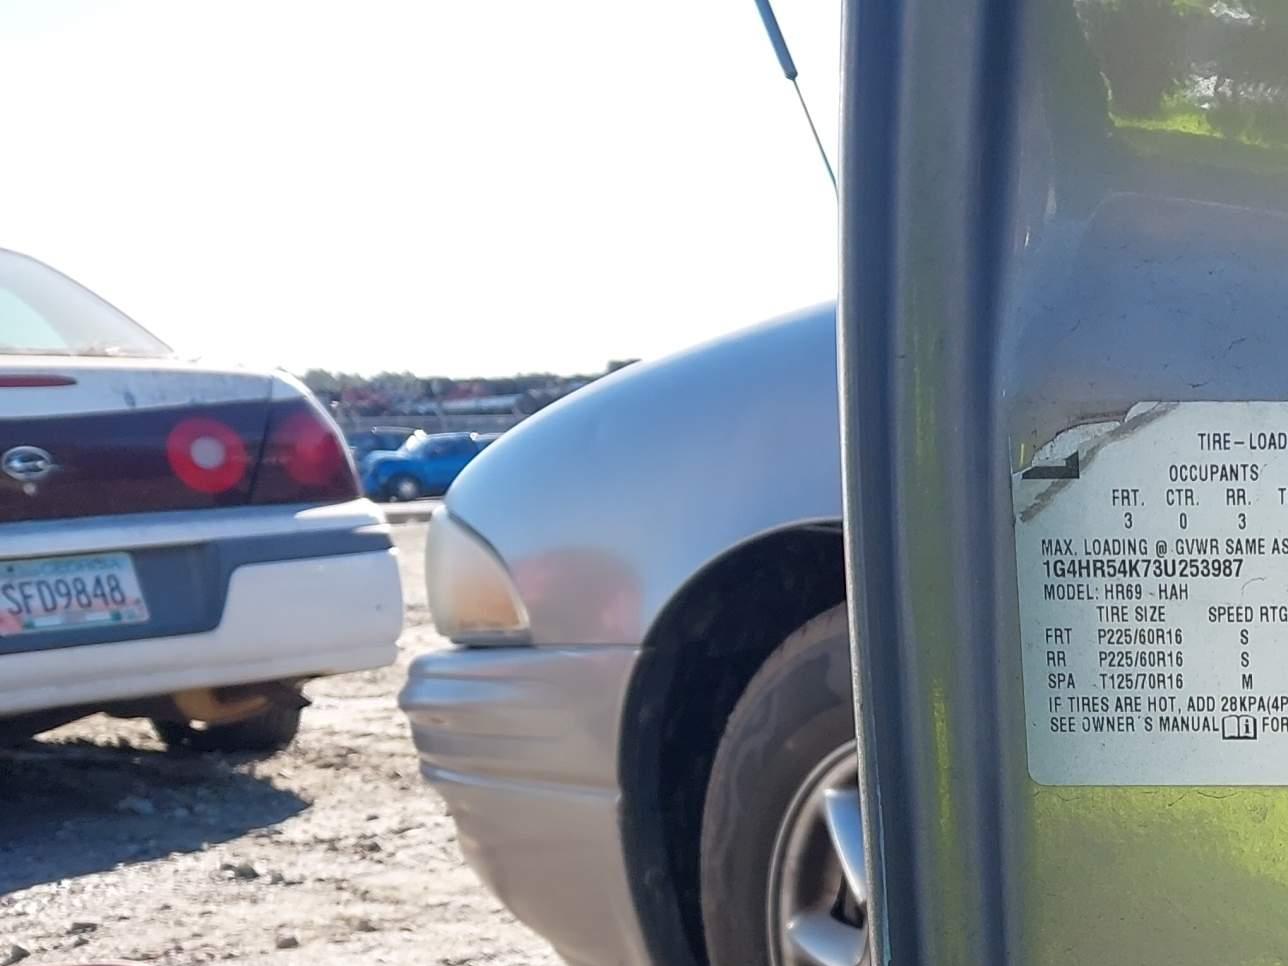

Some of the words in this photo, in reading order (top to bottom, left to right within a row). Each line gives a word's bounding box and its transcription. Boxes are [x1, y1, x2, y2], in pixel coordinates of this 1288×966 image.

[1169, 464, 1258, 482] OCCUPANTS
[1112, 489, 1144, 506] FRT.
[1167, 489, 1199, 506] CTR.
[1227, 488, 1251, 505] RR.
[1124, 512, 1132, 529] 3
[1180, 513, 1187, 529] 0
[1238, 513, 1246, 530] 3
[1042, 539, 1077, 556] MAX.
[1084, 538, 1147, 555] LOADING
[1156, 540, 1167, 558] @
[1175, 538, 1219, 555] GVWR
[1226, 538, 1265, 555] SAME
[1043, 559, 1244, 578] 1G4HR54K73U253987
[1, 574, 126, 616] SFD9848
[1044, 584, 1098, 600] MODEL:
[1105, 583, 1142, 600] HR69
[1159, 584, 1188, 600] HAH
[1096, 605, 1128, 622] TIRE
[1135, 606, 1165, 622] SIZE
[1209, 606, 1253, 623] SPEED
[1260, 606, 1287, 622] RTG
[1046, 628, 1072, 644] FRT
[1098, 628, 1182, 645] P225/60R16
[1240, 629, 1248, 645] S
[1047, 651, 1066, 667] RR
[1099, 651, 1183, 667] P225/60R16
[1241, 652, 1249, 667] S
[1049, 673, 1075, 689] SPA
[1100, 673, 1183, 689] T125/70R16
[1242, 674, 1252, 690] M
[1049, 697, 1061, 712] IF
[1068, 697, 1109, 712] TIRES
[1115, 696, 1141, 712] ARE
[1148, 696, 1181, 715] HOT,
[1187, 696, 1215, 712] ADD
[1051, 717, 1075, 732] SEE
[1159, 716, 1219, 732] MANUAL
[1262, 717, 1288, 732] FOR
